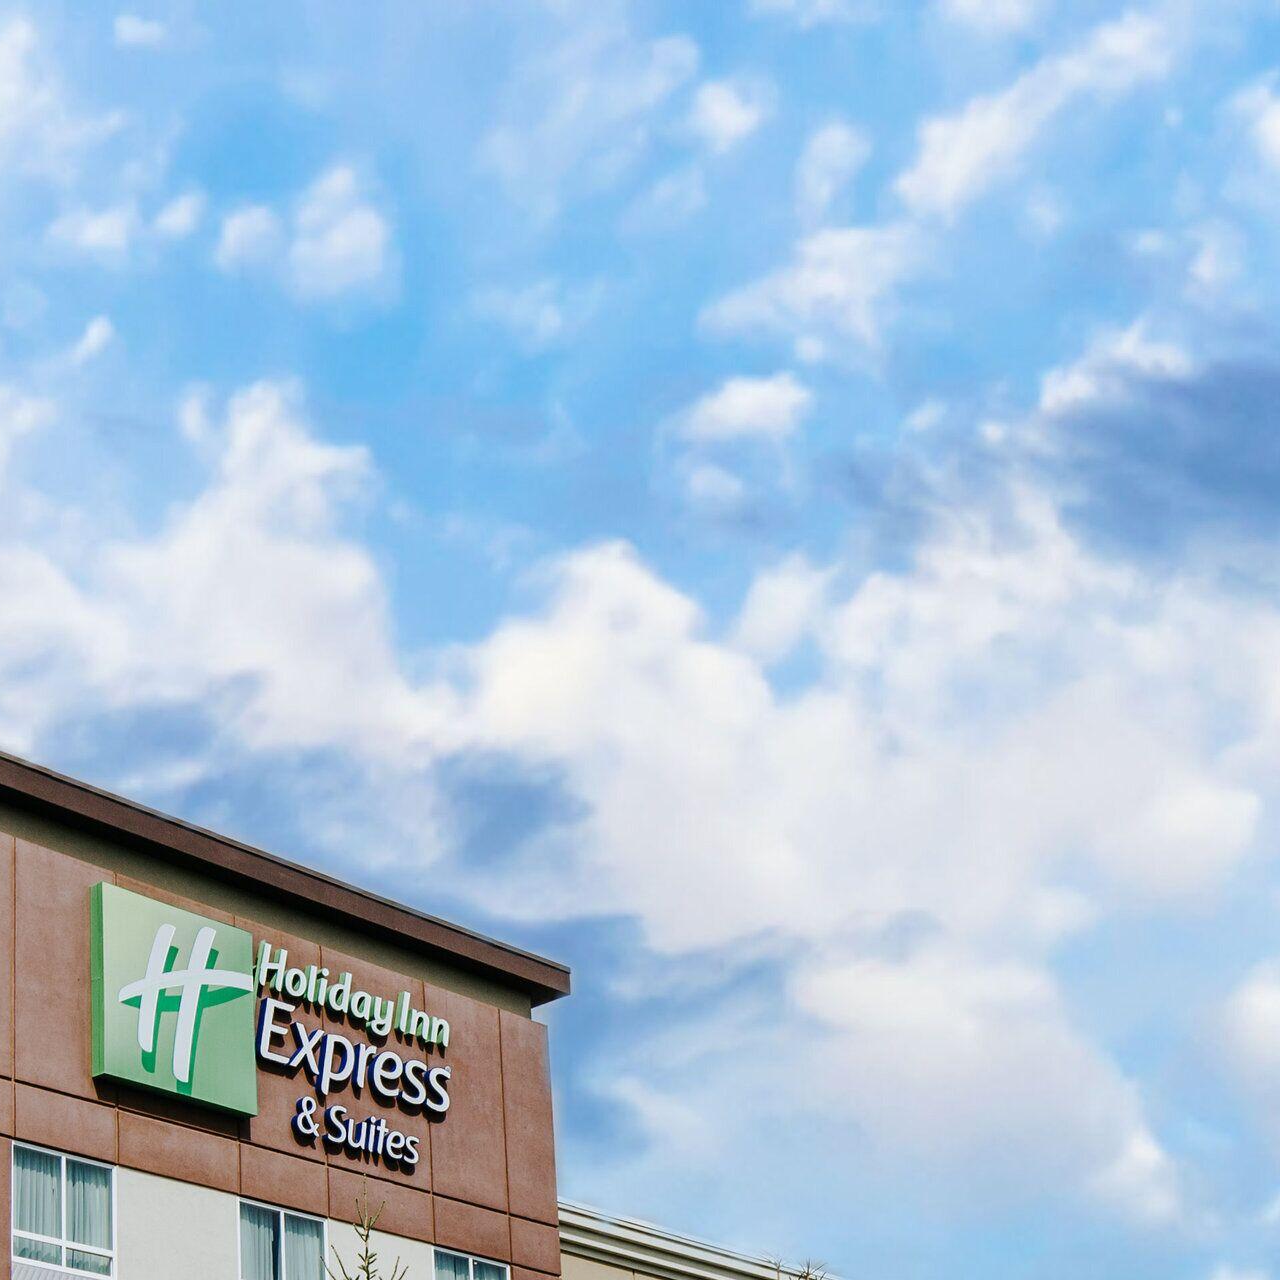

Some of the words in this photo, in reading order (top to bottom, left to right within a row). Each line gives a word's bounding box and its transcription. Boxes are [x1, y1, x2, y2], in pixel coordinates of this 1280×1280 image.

[119, 923, 254, 1083] H
[257, 940, 395, 1037] Holiday
[397, 991, 451, 1048] Inn
[258, 997, 452, 1113] Express
[295, 1095, 320, 1137] &
[324, 1104, 420, 1165] Suites
